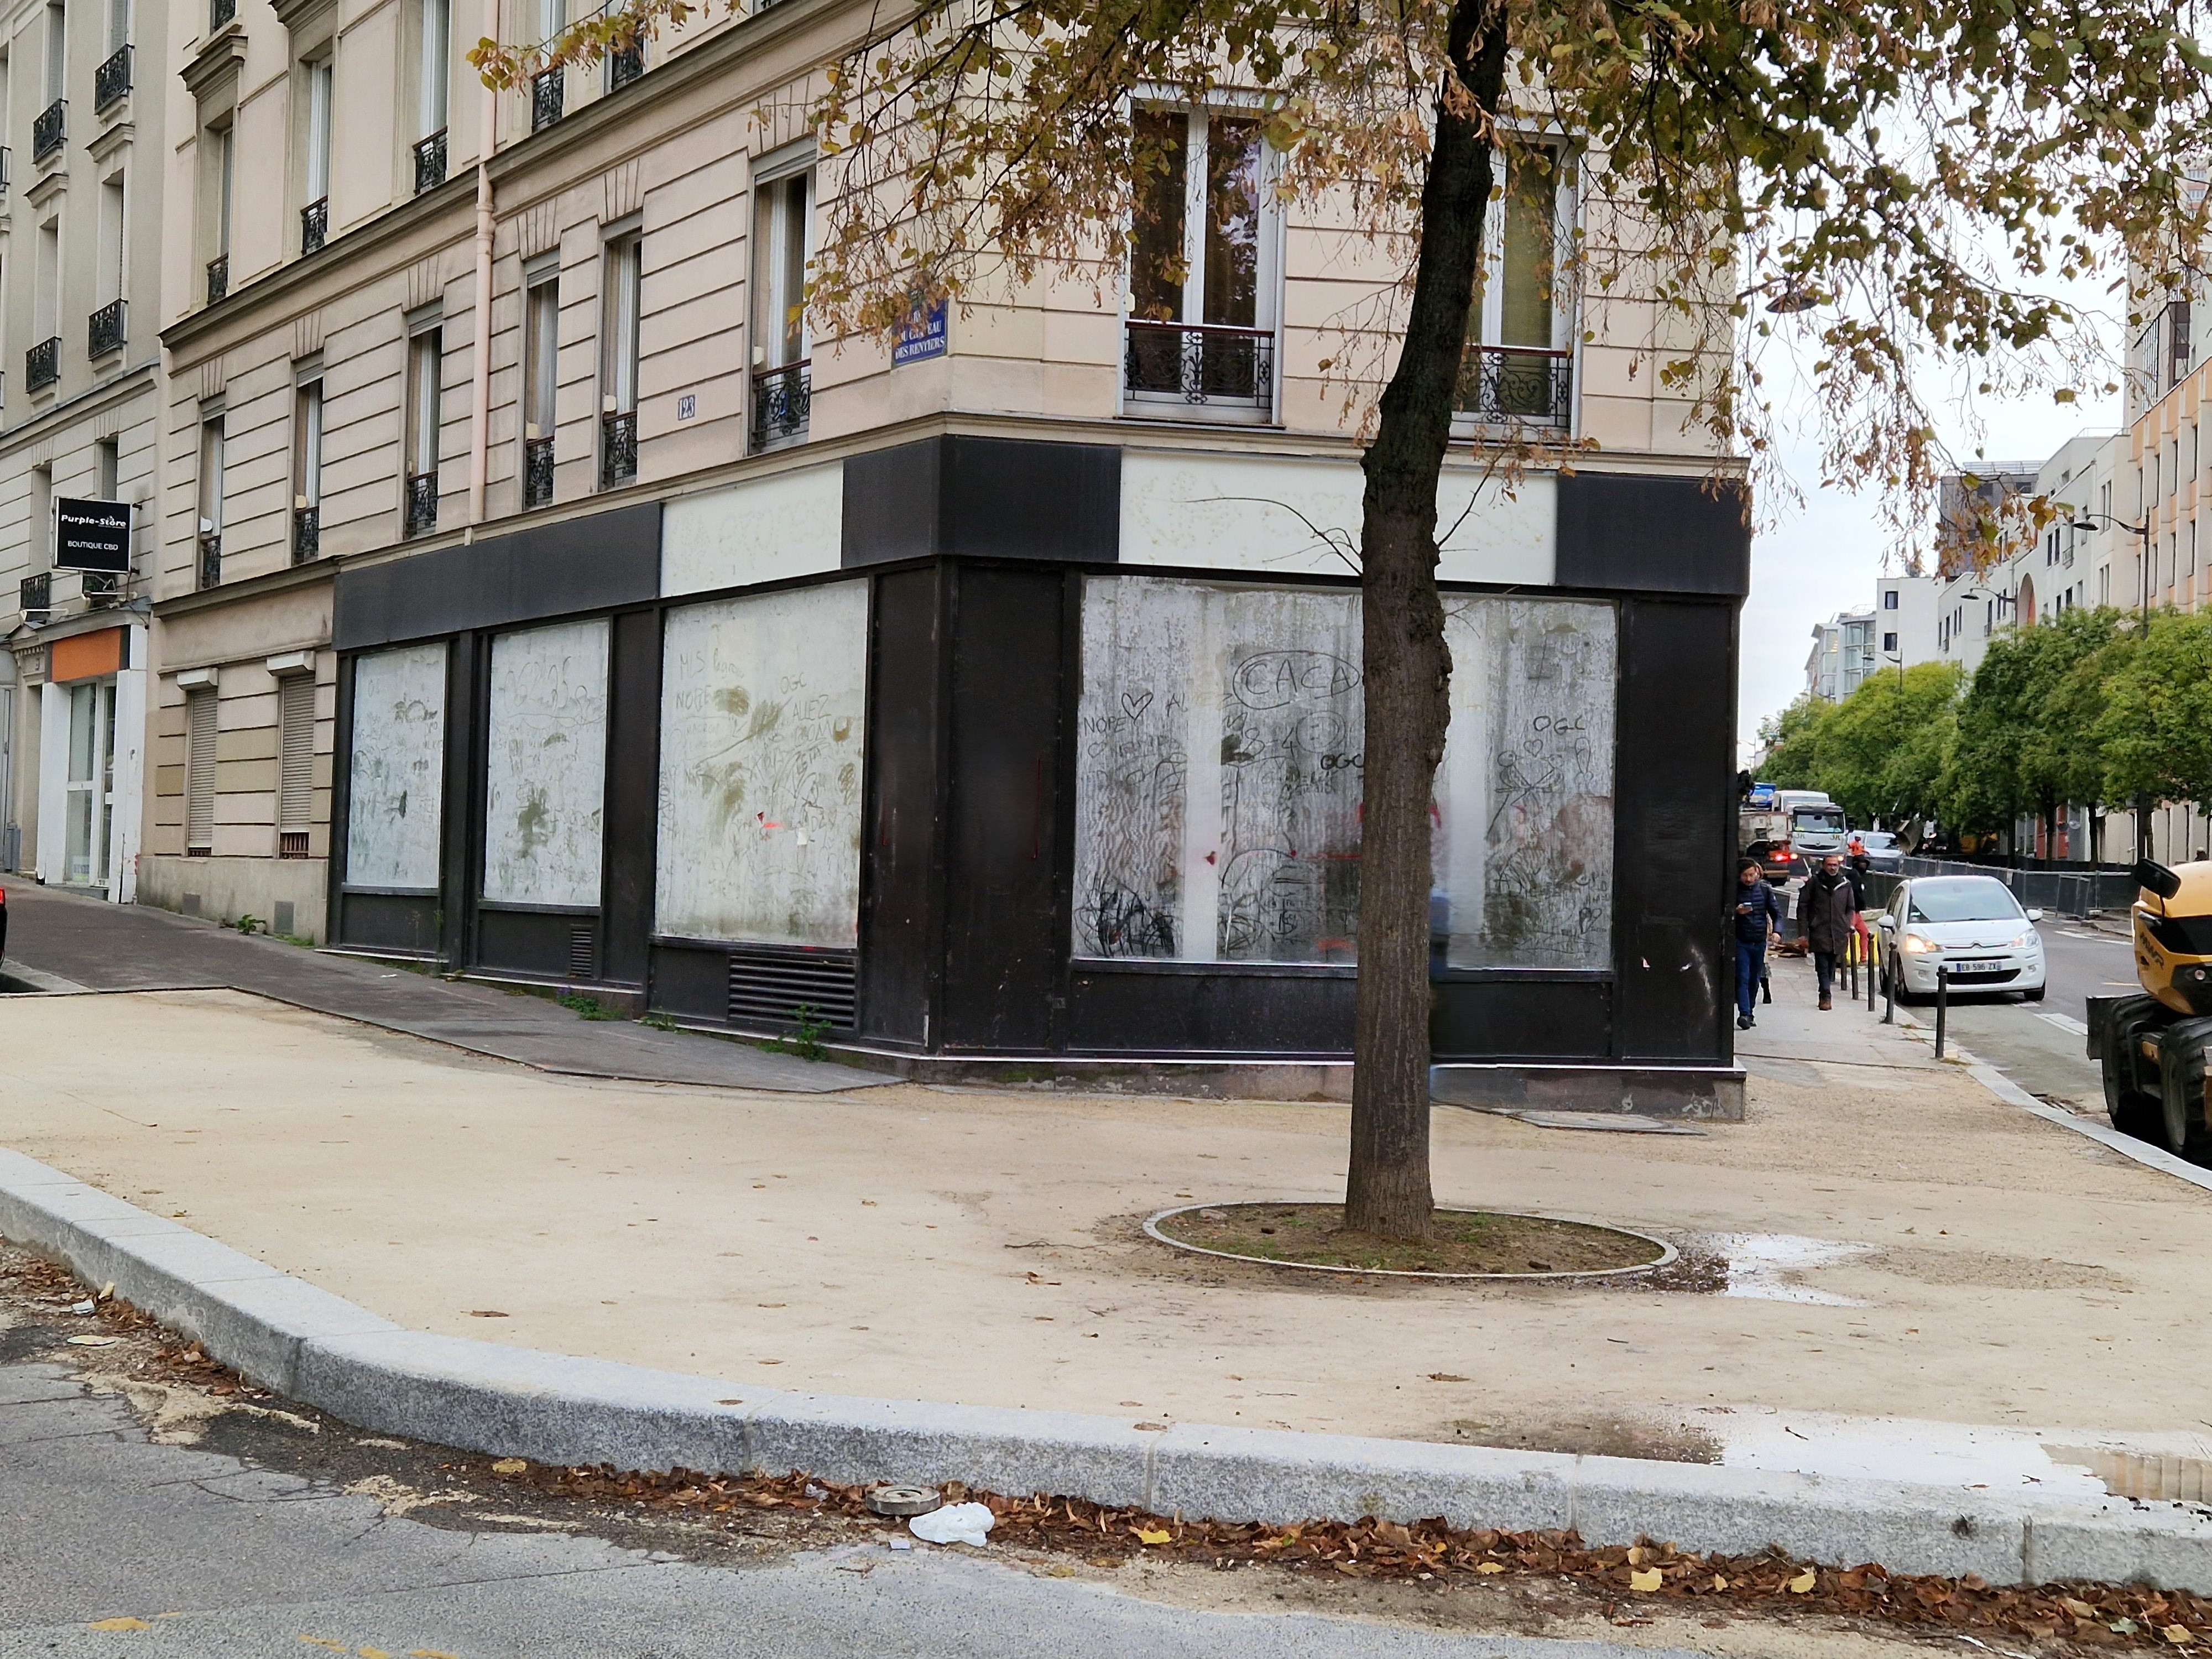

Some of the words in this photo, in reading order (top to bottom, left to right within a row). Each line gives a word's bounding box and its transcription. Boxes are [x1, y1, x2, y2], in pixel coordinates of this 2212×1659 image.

[895, 346, 909, 359] DES
[909, 336, 945, 356] RENTIERS
[679, 397, 694, 419] 123
[67, 540, 103, 550] BOUTIQUE
[1244, 658, 1352, 698] CACA
[1084, 717, 1127, 737] NOPE
